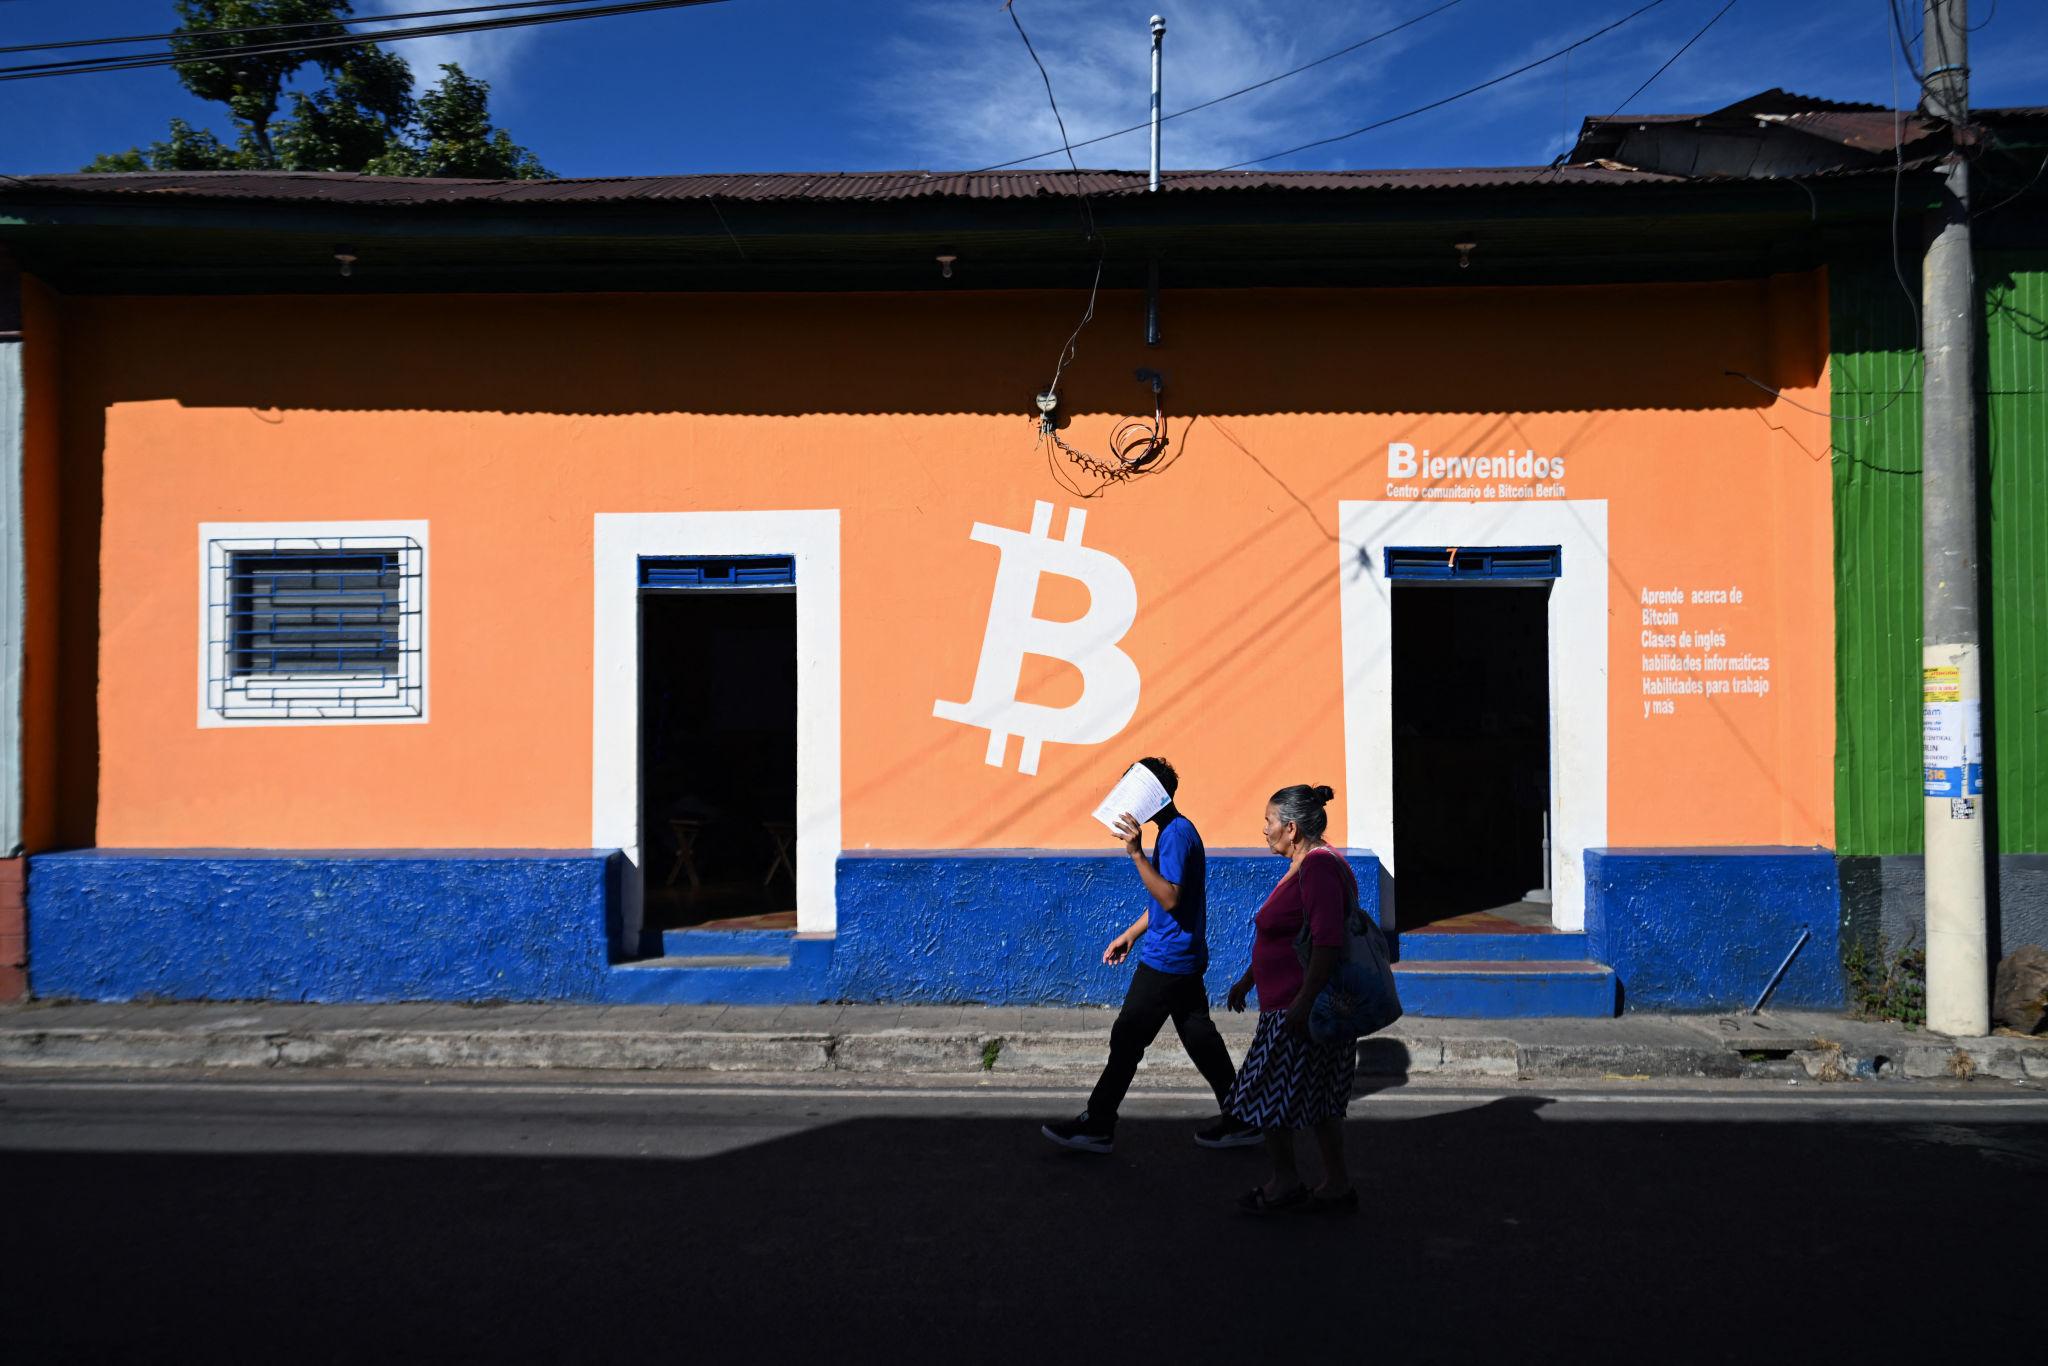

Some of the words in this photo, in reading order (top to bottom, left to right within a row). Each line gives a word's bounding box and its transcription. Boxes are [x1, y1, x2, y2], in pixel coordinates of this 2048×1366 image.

[1387, 442, 1566, 479] Bienvenidos
[1386, 482, 1420, 498] Centro
[1421, 485, 1482, 499] comunitario
[1482, 484, 1497, 498] de
[1498, 483, 1534, 498] Bitcoin
[1640, 586, 1685, 605] Aprende
[1691, 589, 1728, 604] acerca
[1729, 585, 1743, 604] de
[1641, 607, 1679, 625] Bitcoin
[1640, 629, 1677, 648] Clases
[1678, 630, 1693, 648] de
[1642, 676, 1703, 695] Habilidades
[1705, 680, 1730, 699] para
[1731, 675, 1770, 698] trabajo
[1643, 700, 1651, 719] y
